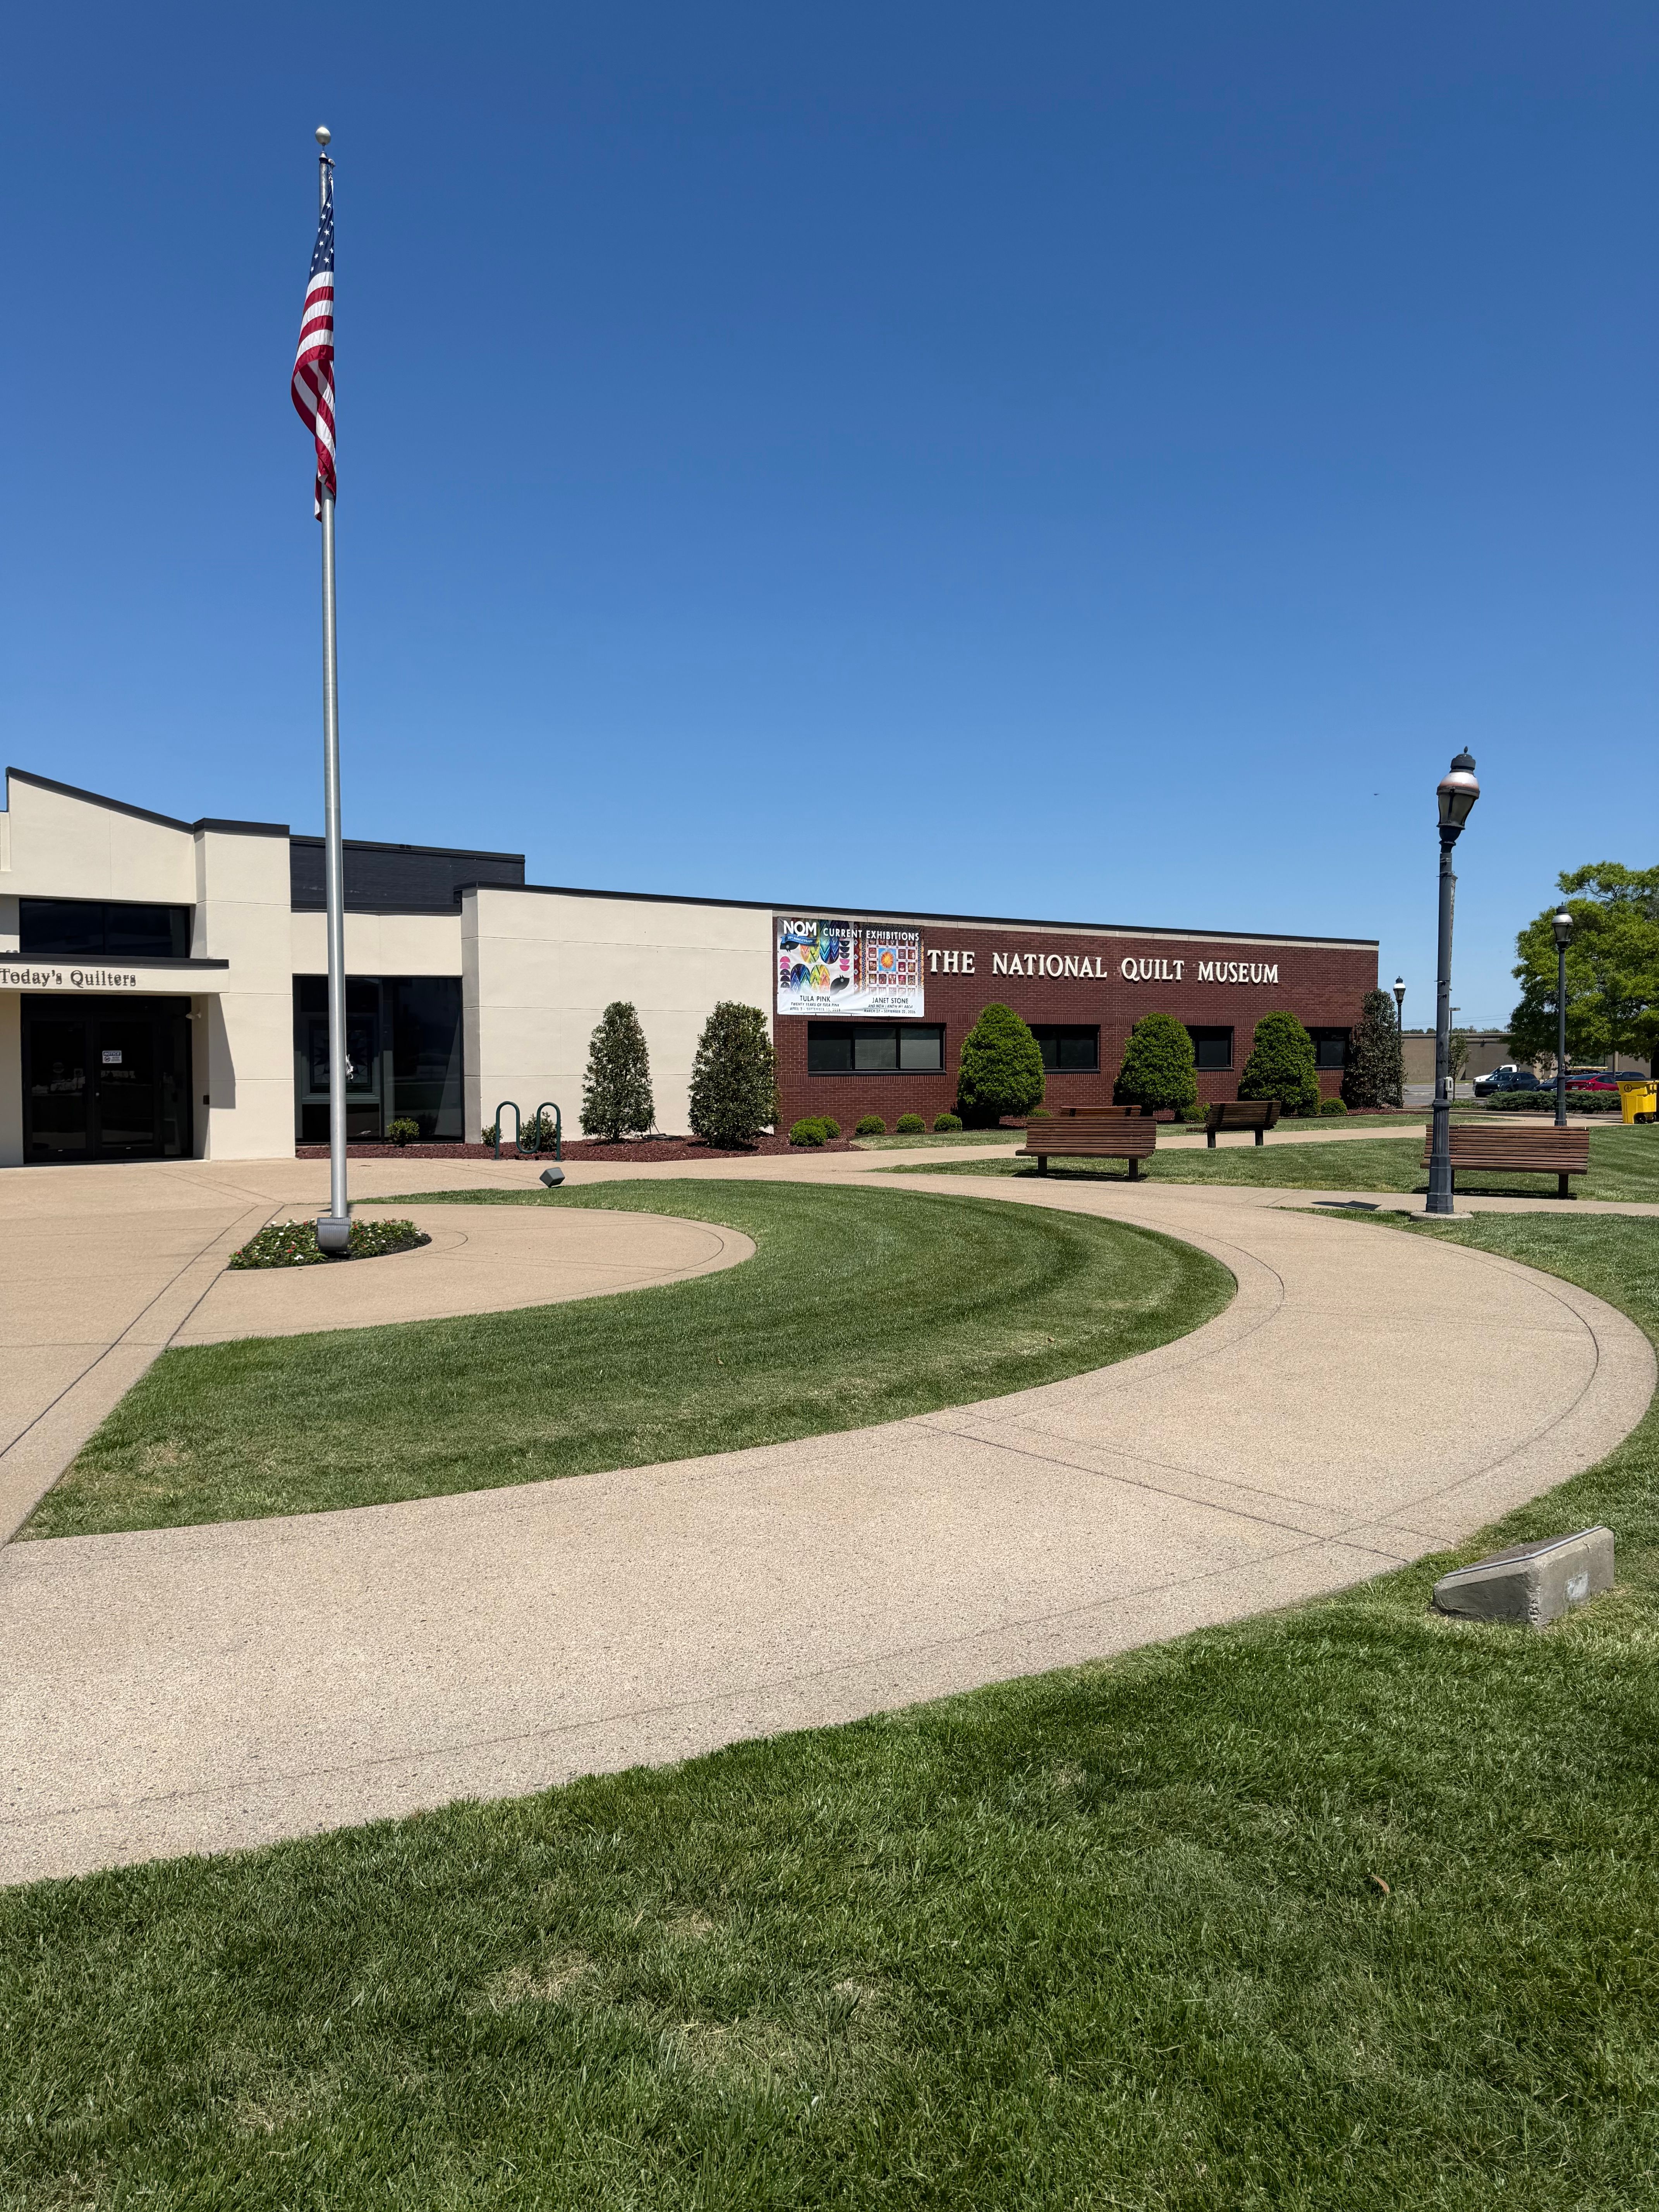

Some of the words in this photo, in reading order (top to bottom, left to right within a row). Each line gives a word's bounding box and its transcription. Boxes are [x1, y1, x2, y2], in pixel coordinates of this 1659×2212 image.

[783, 920, 817, 937] NQM
[823, 928, 862, 938] CURRENT
[866, 930, 919, 941] EXHIBITIONS
[927, 950, 975, 974] THE
[993, 953, 1108, 978] NATIONAL
[1121, 957, 1184, 982] QUILT
[1198, 961, 1279, 984] MUSEUM
[0, 969, 62, 987] Today's
[70, 970, 136, 988] Quilters
